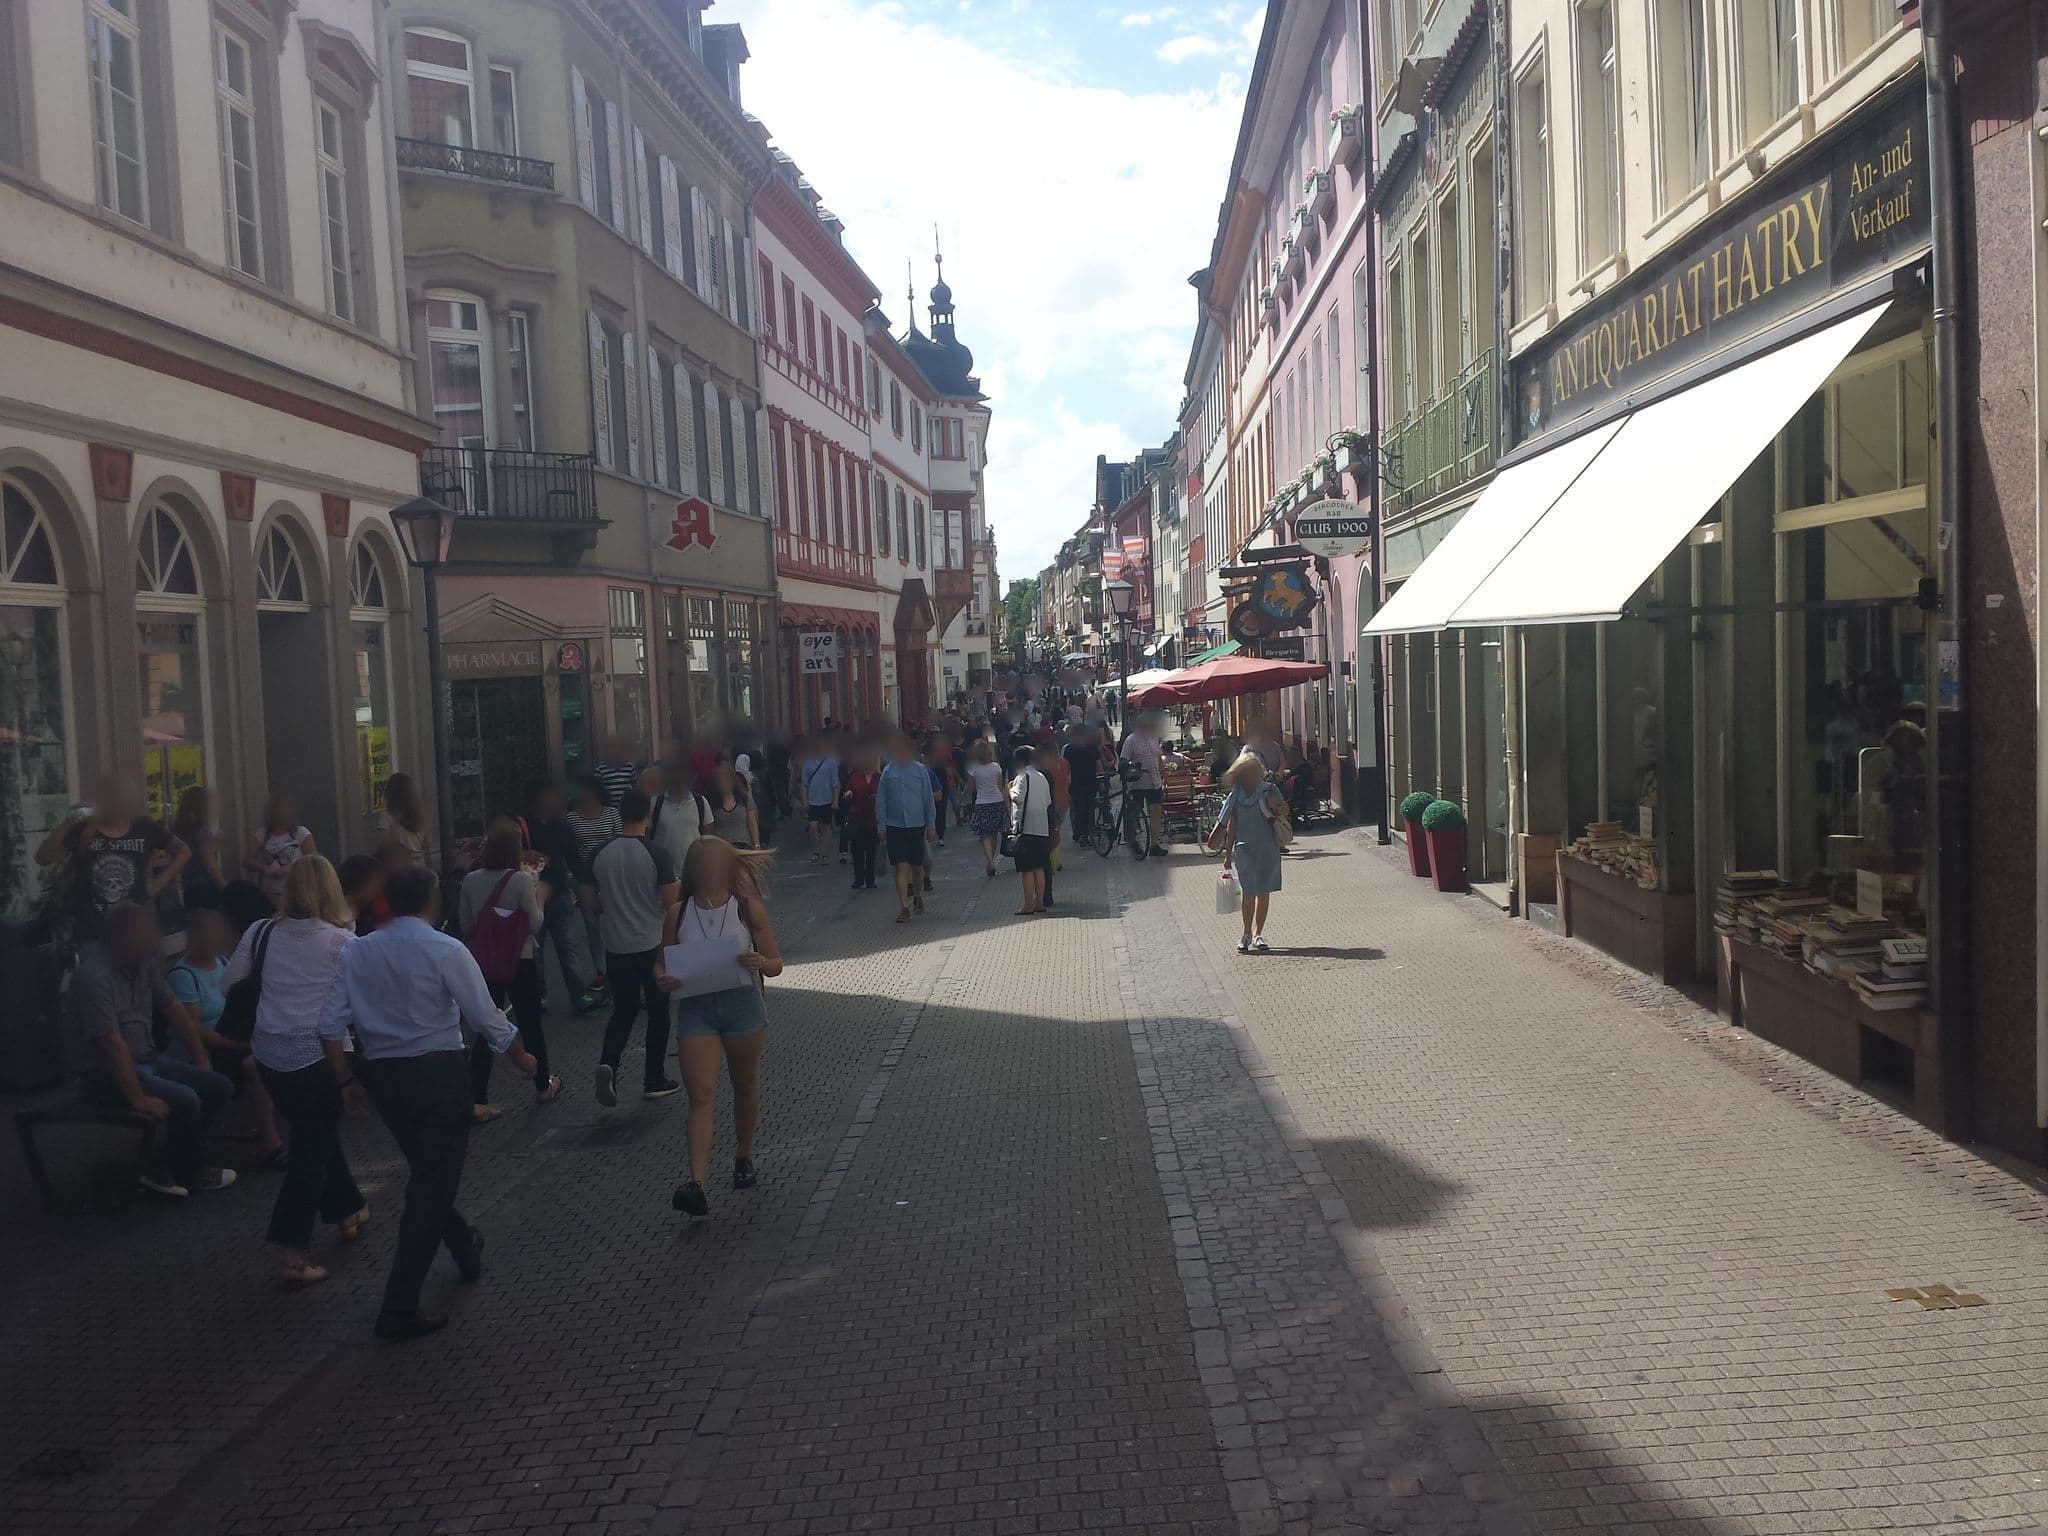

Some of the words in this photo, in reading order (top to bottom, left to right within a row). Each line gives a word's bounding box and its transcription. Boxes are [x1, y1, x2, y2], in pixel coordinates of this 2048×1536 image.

[1850, 161, 1878, 198] An-
[1881, 127, 1913, 178] und
[1850, 178, 1913, 244] Verkauf
[1552, 261, 1707, 406] ANTIQUARIAT
[1711, 183, 1829, 321] HATRY
[1300, 523, 1331, 534] CLUB
[1337, 522, 1369, 533] 1900
[803, 634, 833, 649] eye
[447, 651, 538, 669] PHARMACIE
[804, 657, 833, 669] art
[108, 839, 145, 853] SPIRIT
